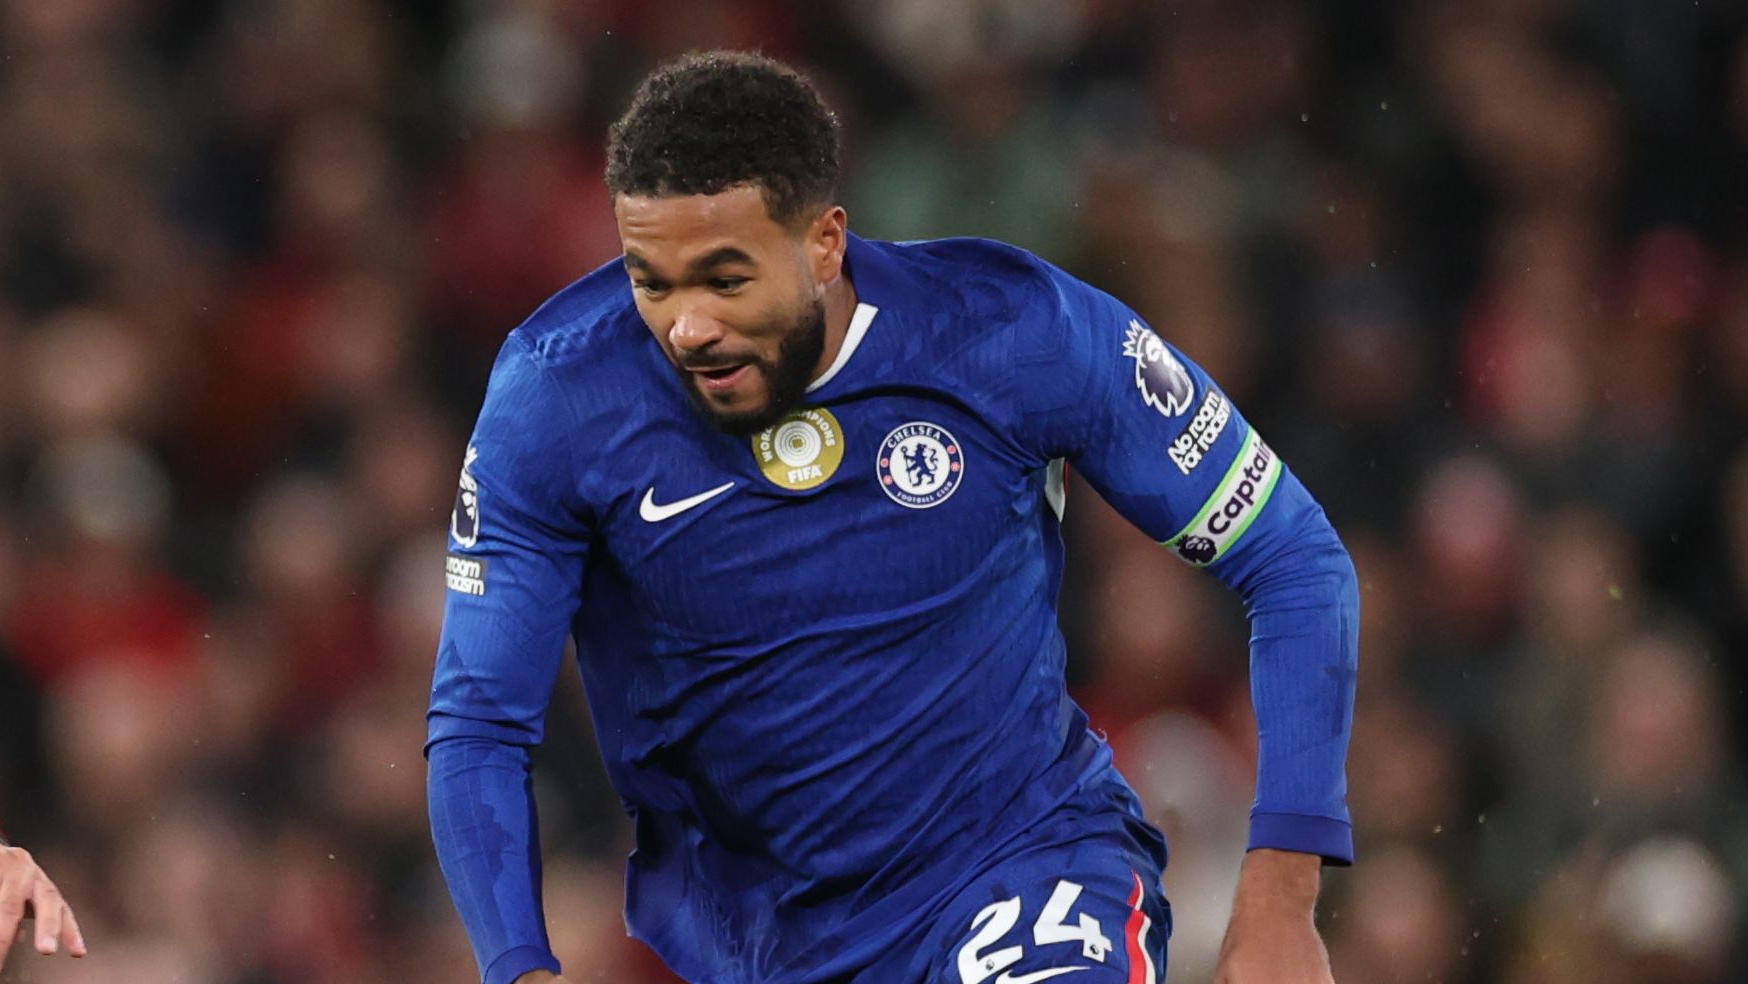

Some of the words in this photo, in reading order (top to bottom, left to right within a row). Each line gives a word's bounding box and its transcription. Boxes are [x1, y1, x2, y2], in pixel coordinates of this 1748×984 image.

[887, 426, 941, 448] CHELSEA
[1168, 433, 1193, 463] No
[1188, 391, 1221, 439] room
[1176, 443, 1202, 475] for
[788, 464, 823, 483] FIFA
